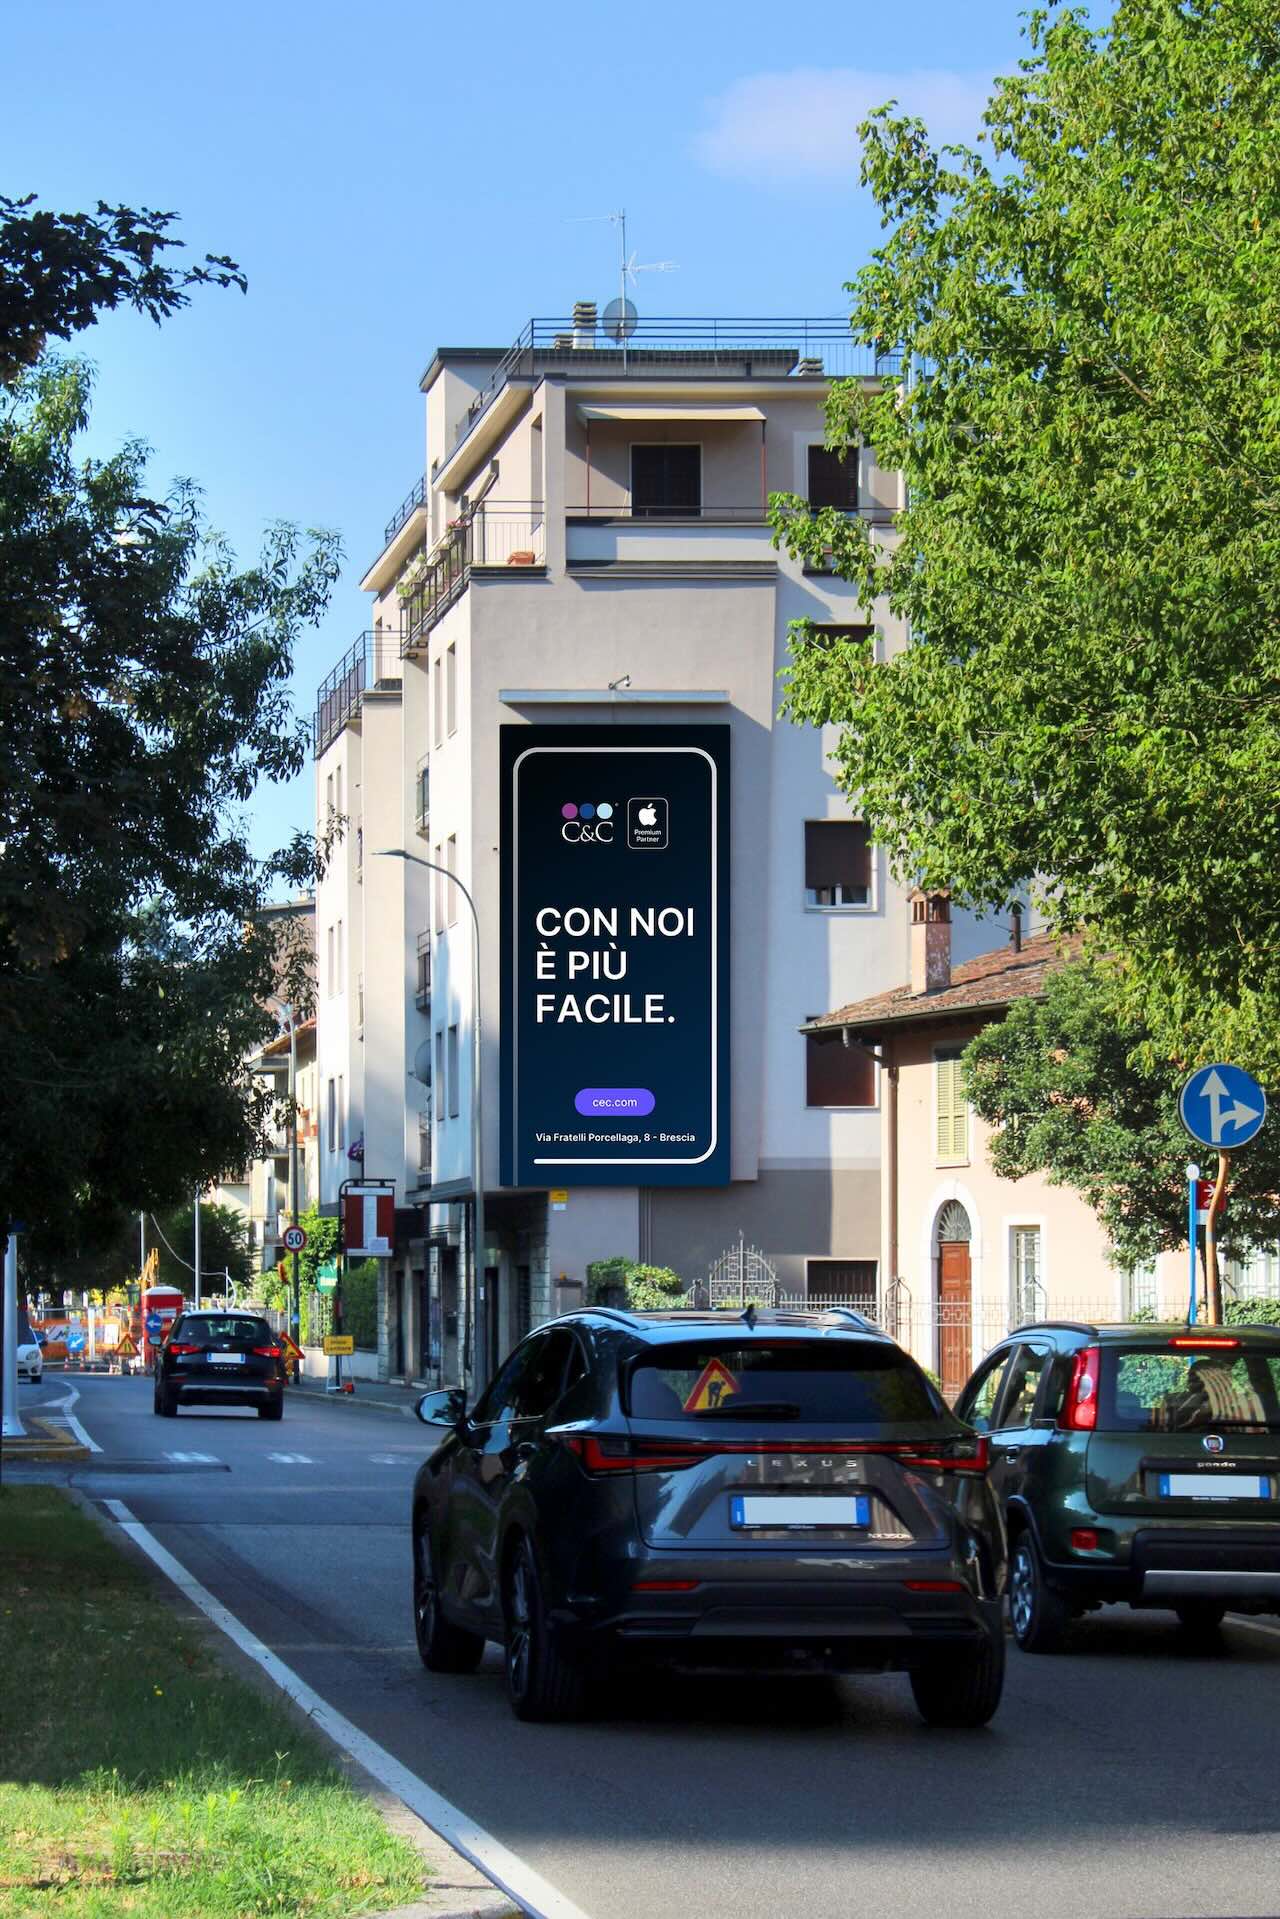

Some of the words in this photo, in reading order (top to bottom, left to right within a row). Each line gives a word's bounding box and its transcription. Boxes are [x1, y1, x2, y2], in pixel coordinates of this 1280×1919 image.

[561, 821, 614, 843] C&C
[535, 907, 618, 937] CON
[630, 907, 694, 937] NOI
[536, 942, 556, 980] È
[568, 942, 627, 980] PIÙ
[536, 993, 676, 1024] FACILE.
[592, 1098, 638, 1108] cec.com
[535, 1132, 552, 1142] Via
[553, 1132, 587, 1142] Fratelli
[588, 1132, 642, 1145] Porcellaga,
[643, 1132, 651, 1142] 8
[659, 1132, 696, 1142] Brescia
[287, 1231, 303, 1246] 50
[747, 1459, 857, 1468] LEXUS
